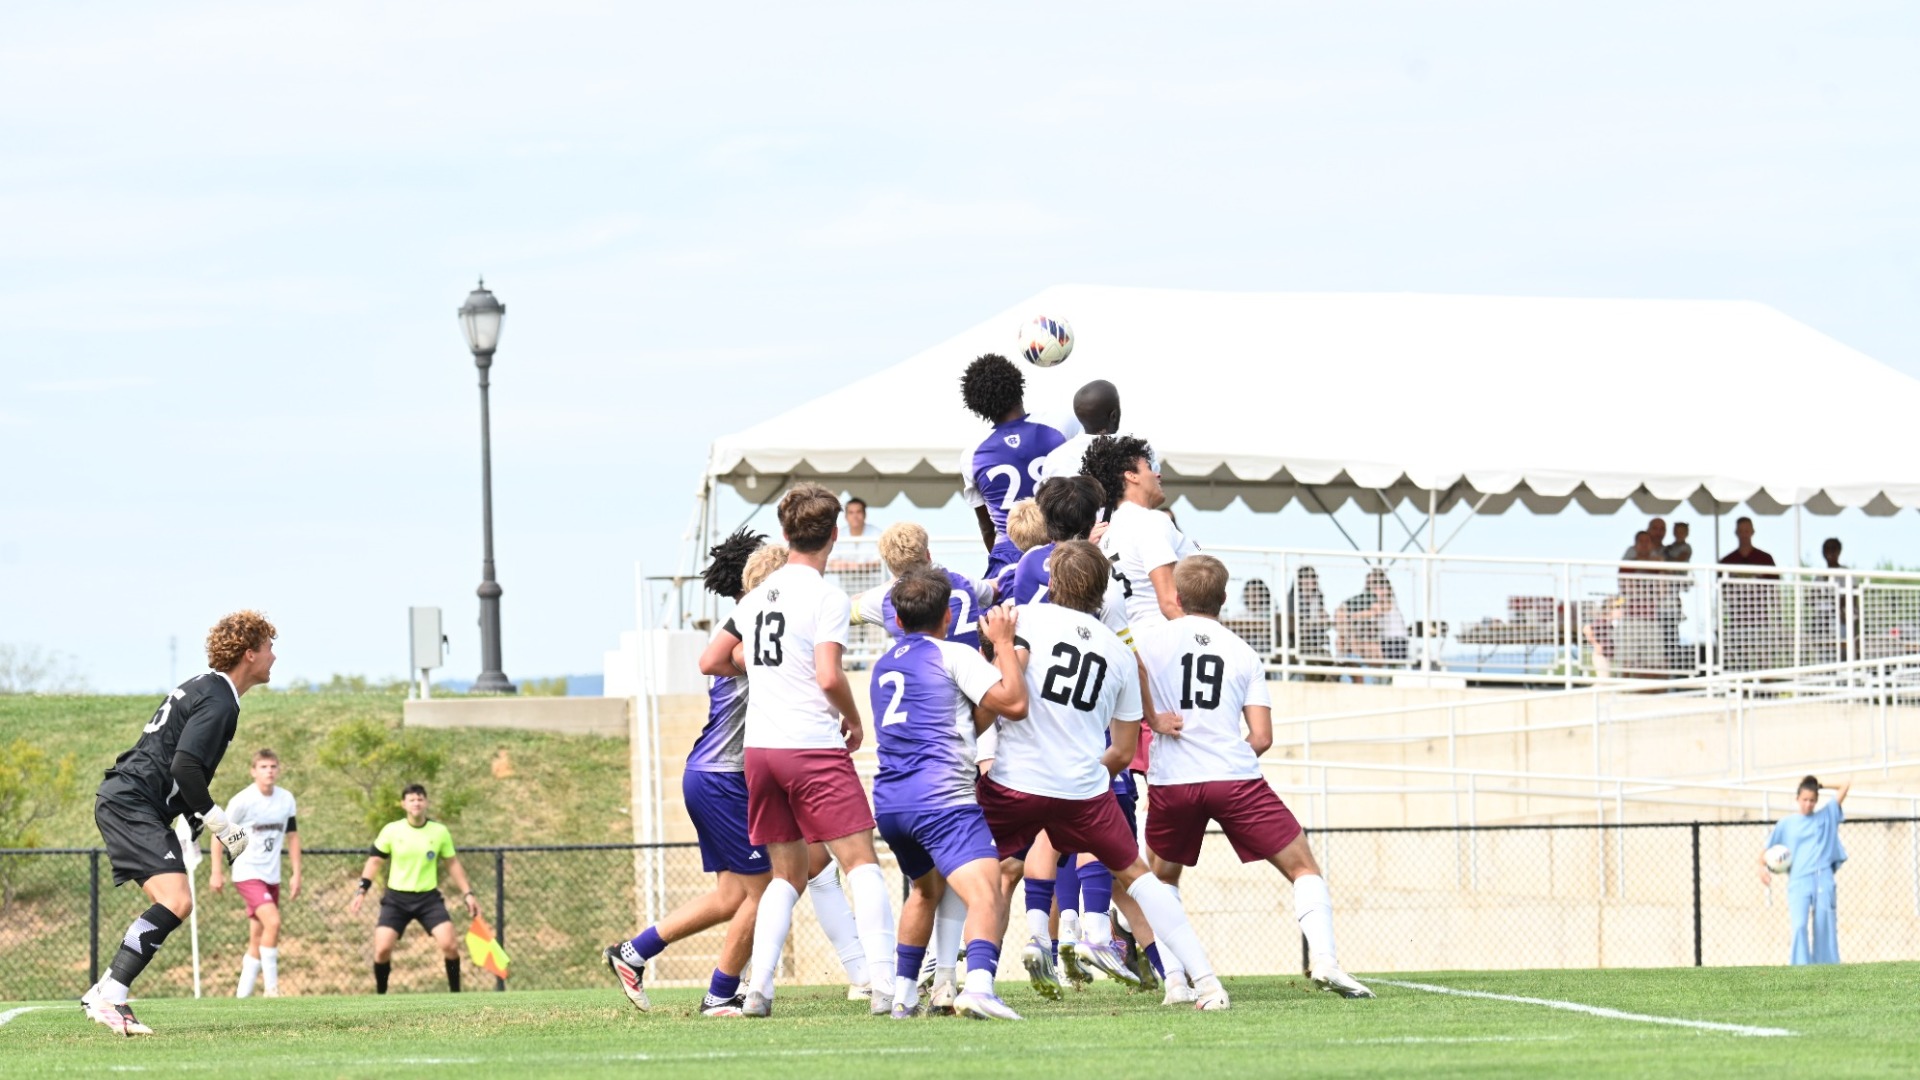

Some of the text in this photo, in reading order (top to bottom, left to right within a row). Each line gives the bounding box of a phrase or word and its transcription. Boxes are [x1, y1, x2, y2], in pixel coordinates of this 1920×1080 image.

[753, 610, 786, 667] 13
[878, 671, 908, 728] 2
[1041, 641, 1108, 712] 20
[1180, 652, 1225, 710] 19
